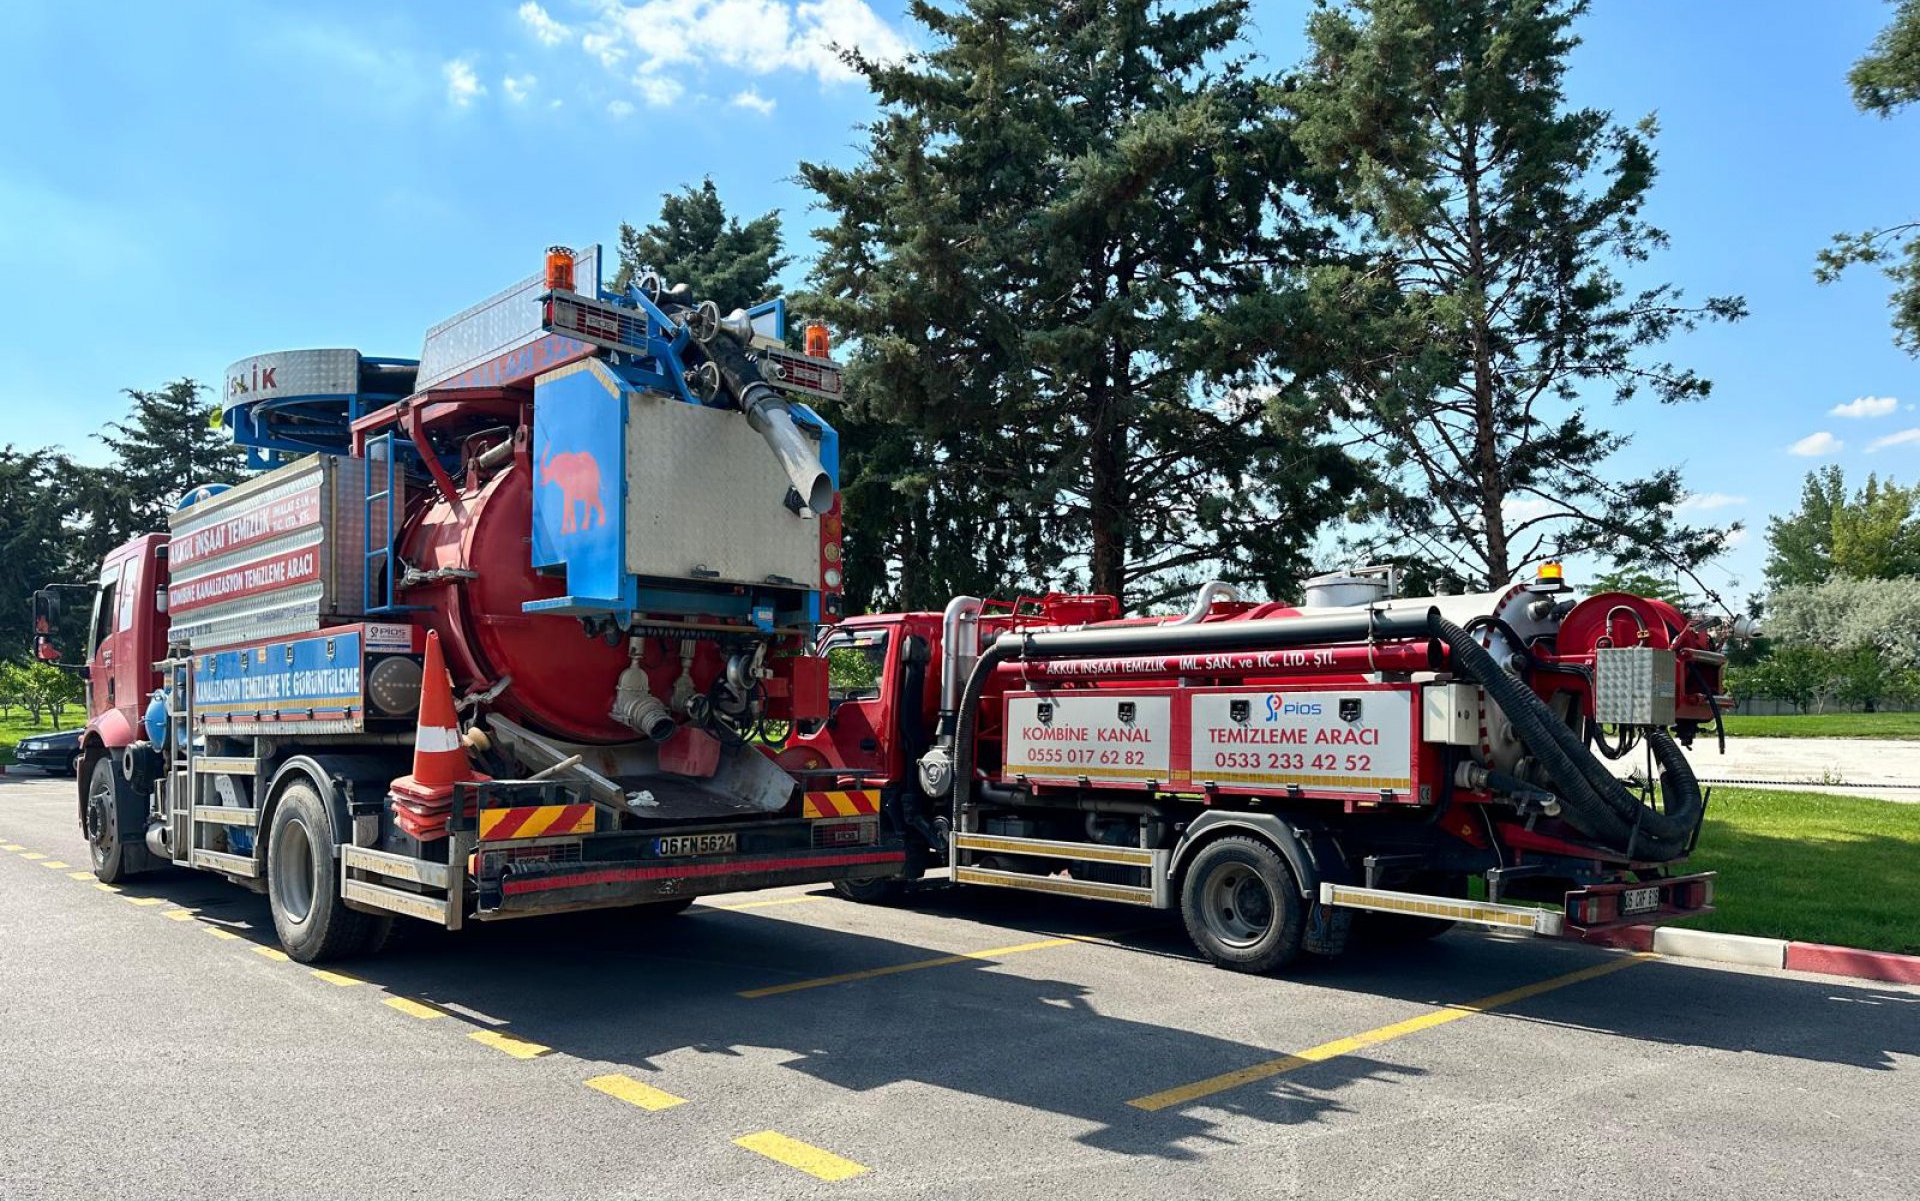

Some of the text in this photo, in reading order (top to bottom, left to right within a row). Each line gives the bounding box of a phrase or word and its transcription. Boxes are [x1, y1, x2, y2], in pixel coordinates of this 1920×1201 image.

[287, 553, 313, 579] ARACI
[1205, 655, 1235, 669] SAN.
[1238, 658, 1253, 668] ve
[1283, 650, 1309, 666] LTD.
[1023, 723, 1152, 742] KOMBİNE KANAL
[1208, 724, 1379, 745] TEMİZLEME ARACI
[1027, 748, 1145, 765] 0555 017 62 82
[1215, 752, 1371, 771] 0533 233 42 52
